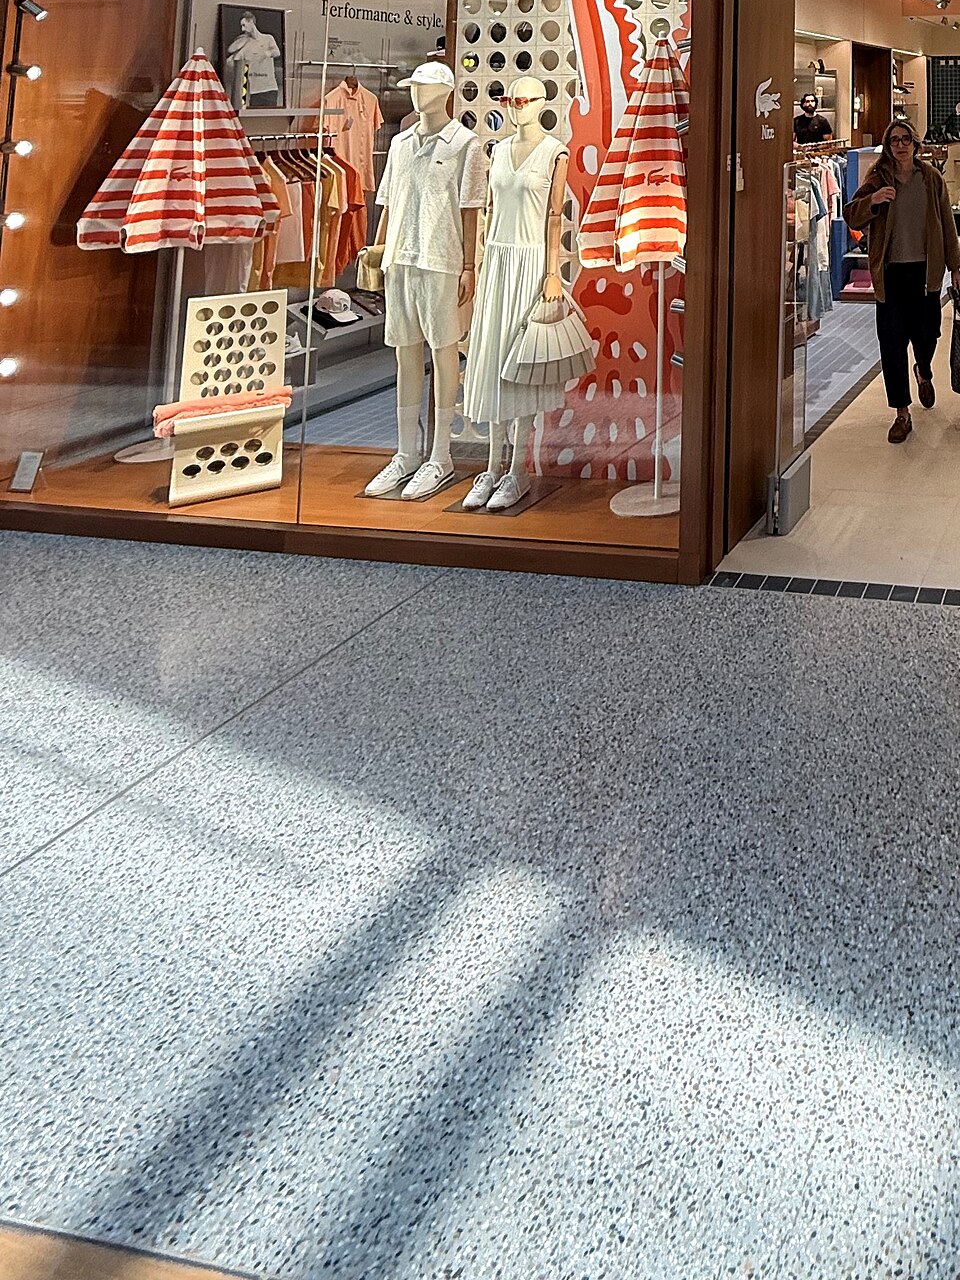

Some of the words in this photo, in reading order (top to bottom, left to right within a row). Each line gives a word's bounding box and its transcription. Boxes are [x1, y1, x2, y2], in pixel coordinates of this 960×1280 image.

[321, 0, 400, 24] Performance
[403, 9, 413, 26] &
[416, 12, 444, 30] style.
[761, 124, 775, 140] Nice
